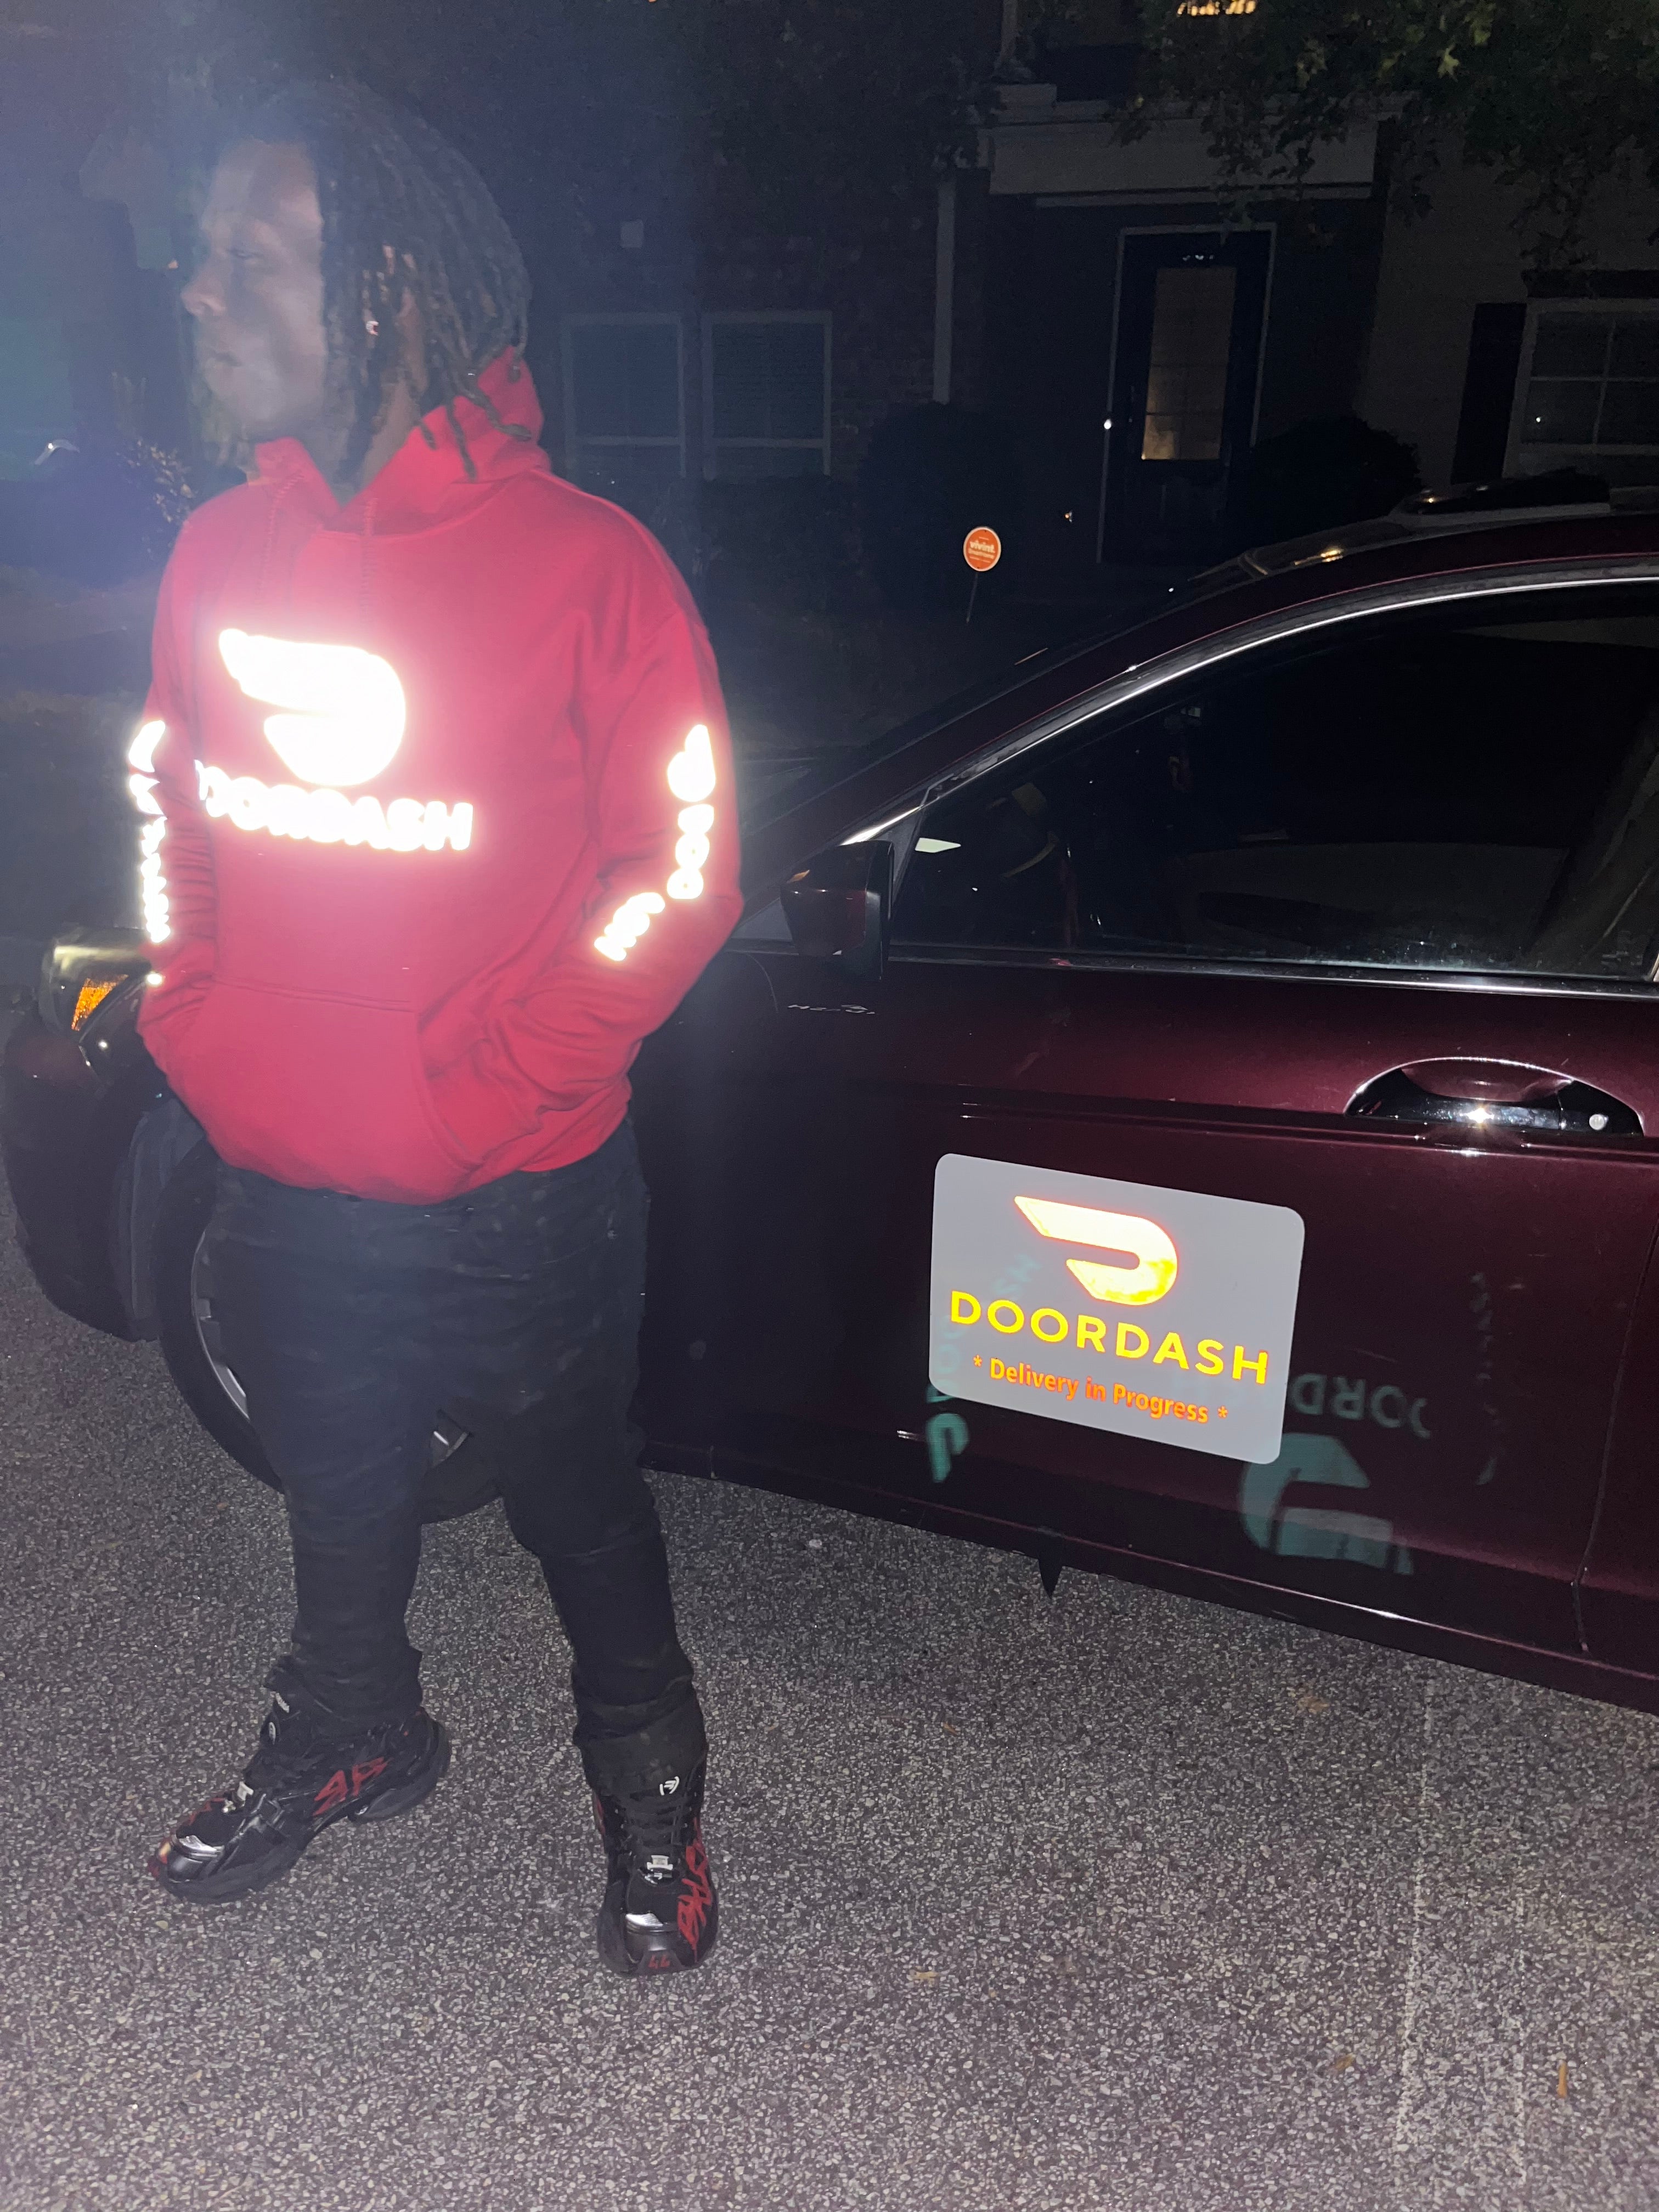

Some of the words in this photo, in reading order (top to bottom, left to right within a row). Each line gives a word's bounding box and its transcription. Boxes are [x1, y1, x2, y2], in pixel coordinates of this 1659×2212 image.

[950, 1290, 1268, 1385] DOORDASH
[990, 1357, 1079, 1401] Delivery
[1085, 1376, 1107, 1402] in
[1113, 1383, 1209, 1424] Progress
